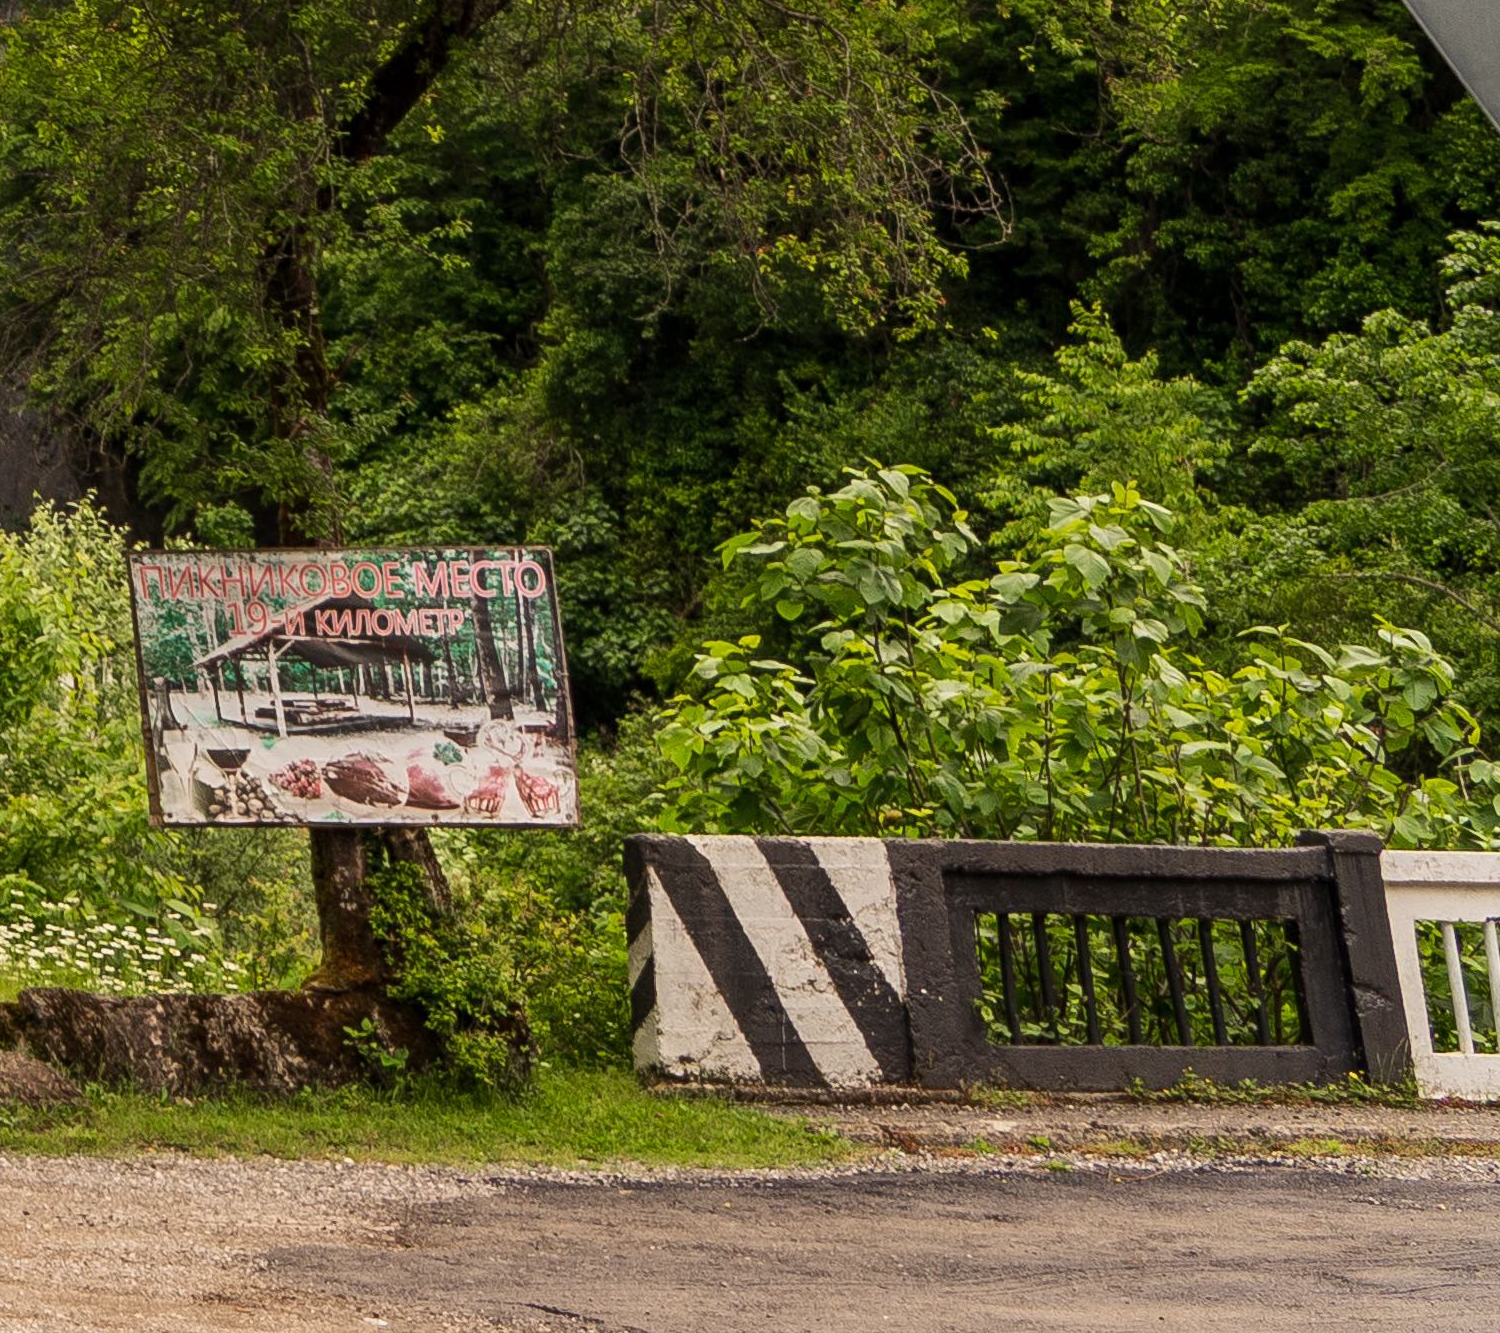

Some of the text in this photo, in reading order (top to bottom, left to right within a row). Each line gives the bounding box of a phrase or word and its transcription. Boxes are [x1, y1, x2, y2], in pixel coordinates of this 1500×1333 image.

[139, 560, 546, 599] ПИКНИКОВОЕ МЕСТО
[314, 607, 465, 637] КИЛОМЕТР
